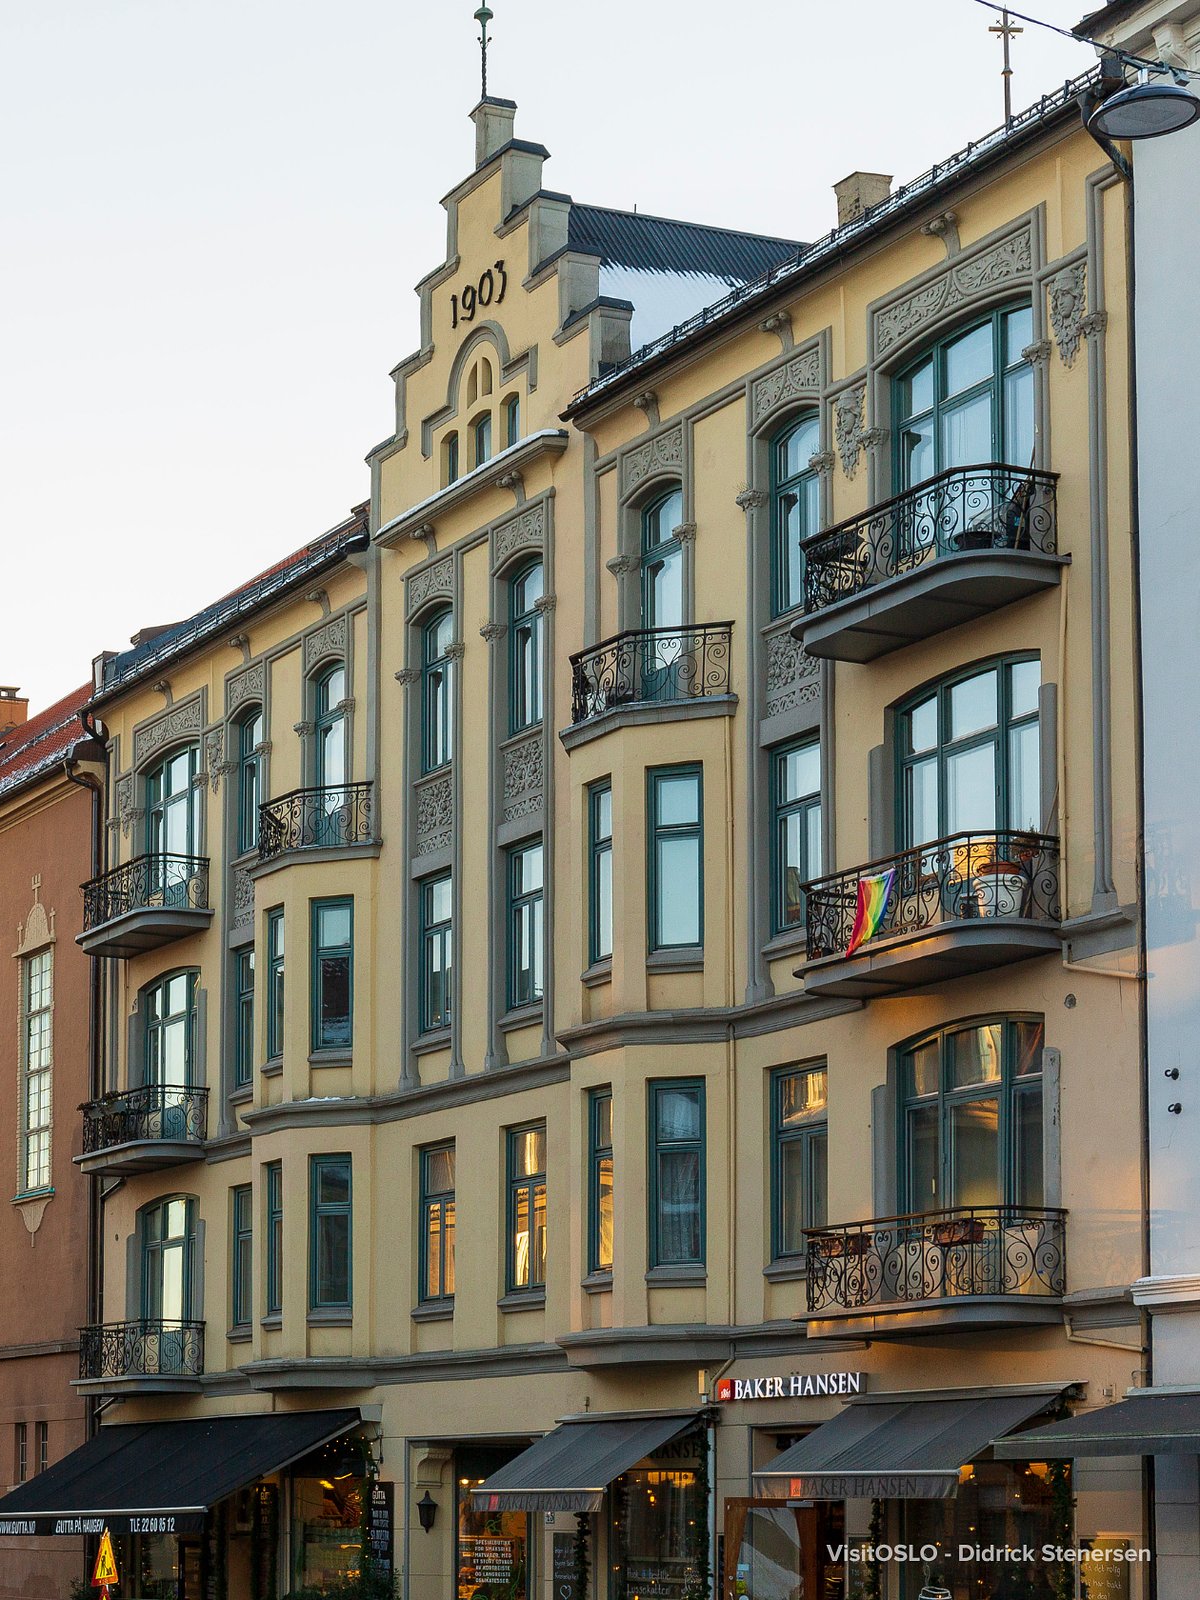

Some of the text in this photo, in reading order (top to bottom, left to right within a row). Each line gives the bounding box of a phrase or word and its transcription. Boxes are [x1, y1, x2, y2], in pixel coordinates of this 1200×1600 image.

[734, 1376, 785, 1400] BAKER
[790, 1371, 861, 1397] HANSEN
[653, 1440, 701, 1458] ANSE
[802, 1477, 849, 1496] BAKER
[854, 1477, 918, 1497] HANSEN
[500, 1494, 534, 1509] BAKER
[536, 1494, 584, 1509] HANSEN
[55, 1516, 105, 1534] GUTTA PÅ HAUGEN
[141, 1517, 149, 1533] 22
[150, 1517, 158, 1533] 60
[167, 1517, 175, 1532] 12
[1095, 1564, 1104, 1573] det
[1106, 1565, 1121, 1577] rolig
